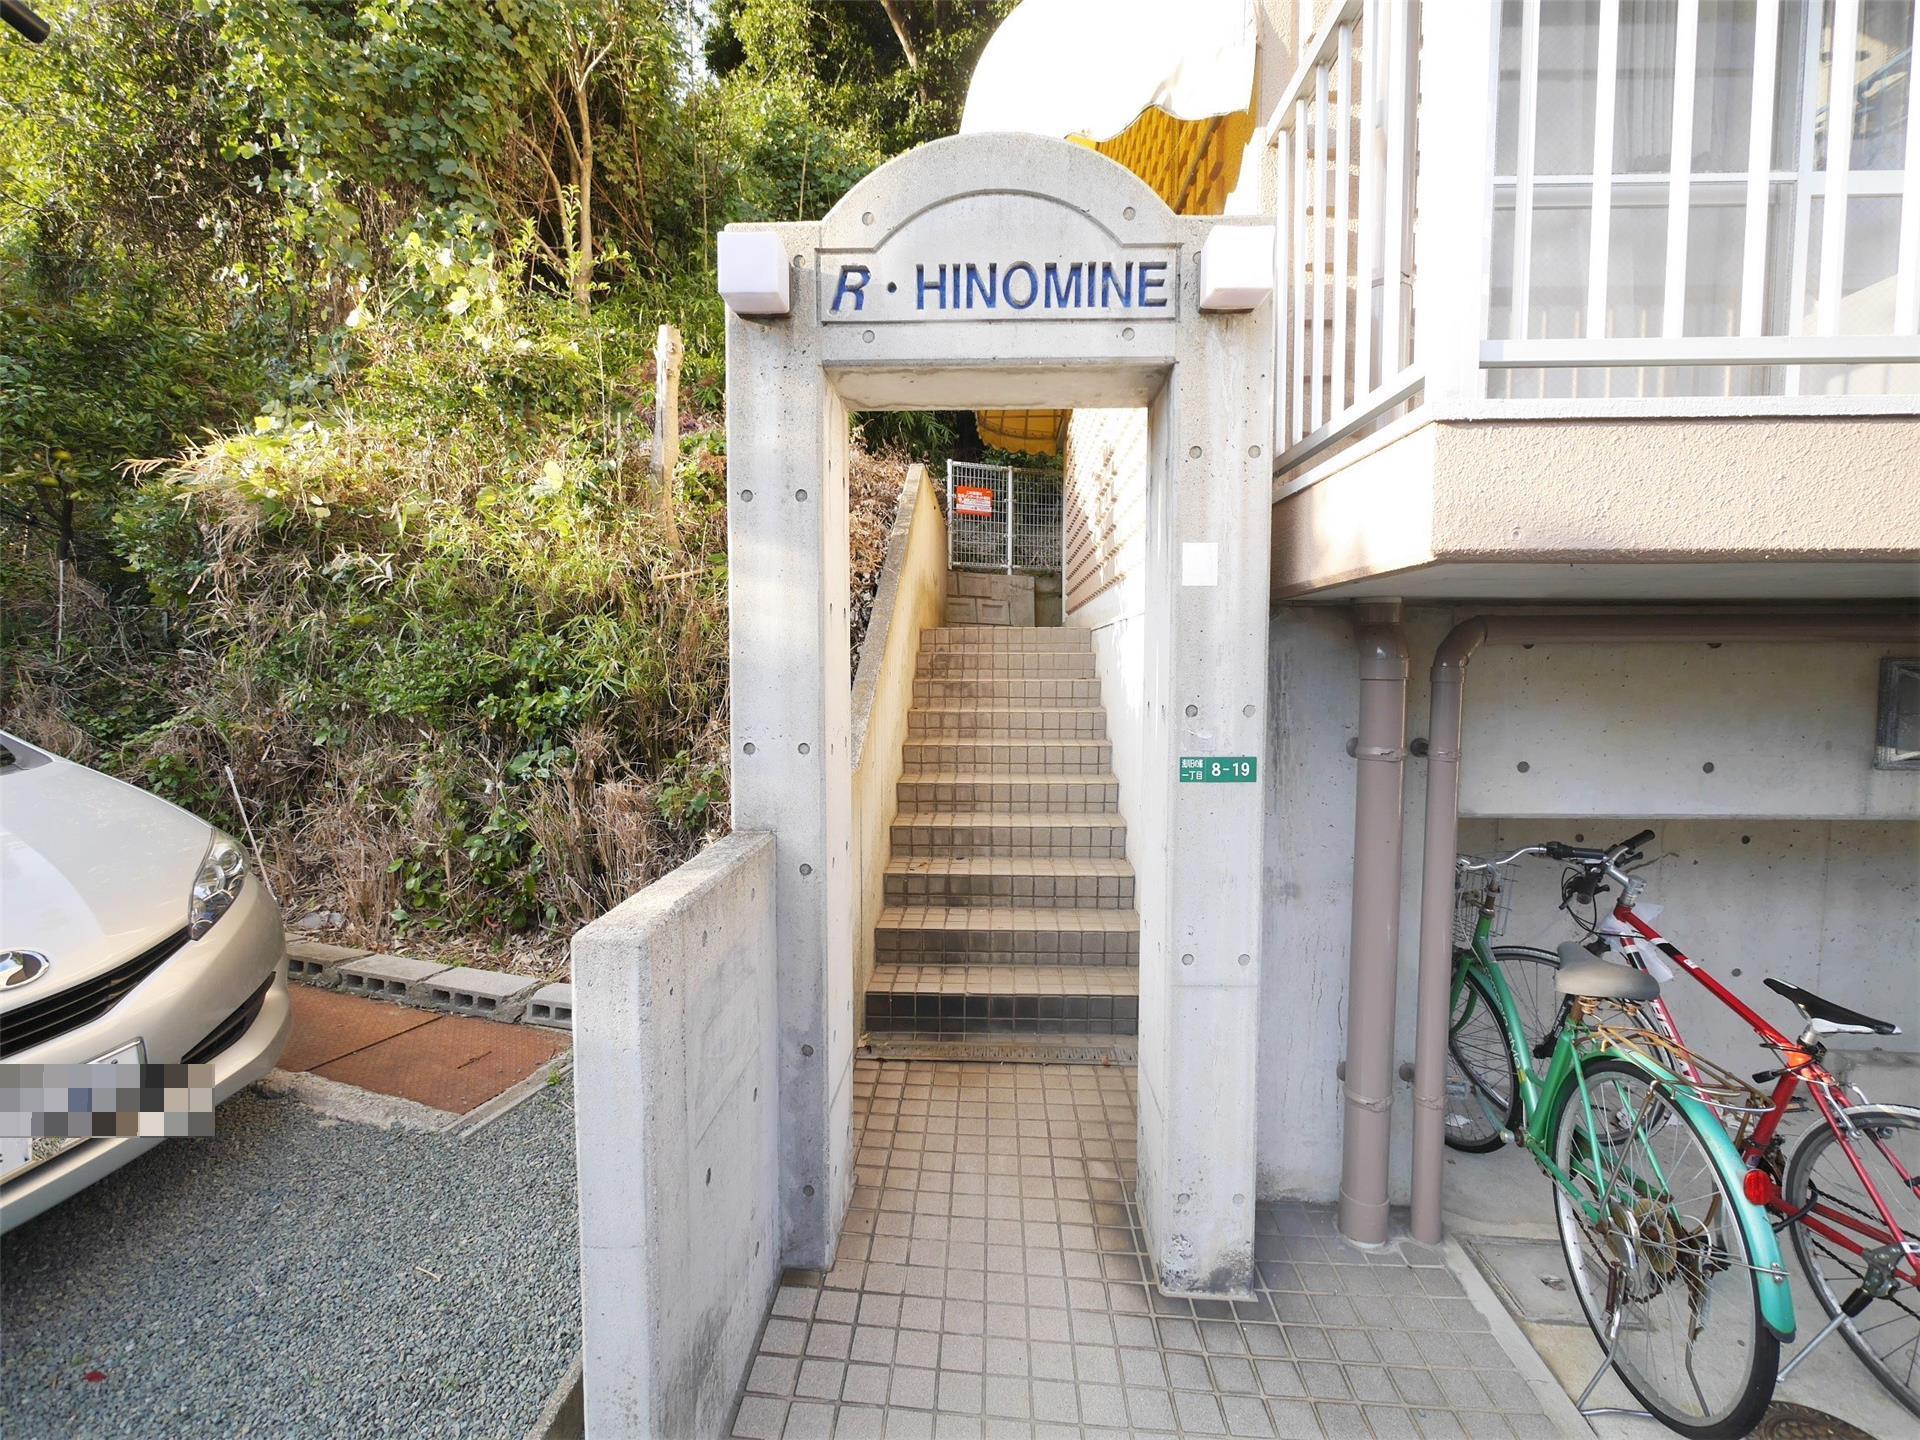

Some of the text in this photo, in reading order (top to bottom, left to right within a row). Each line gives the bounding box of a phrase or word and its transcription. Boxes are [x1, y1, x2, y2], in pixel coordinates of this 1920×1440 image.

[831, 264, 871, 311] R
[915, 260, 1168, 310] HINOMINE
[1211, 762, 1250, 777] 8-19
